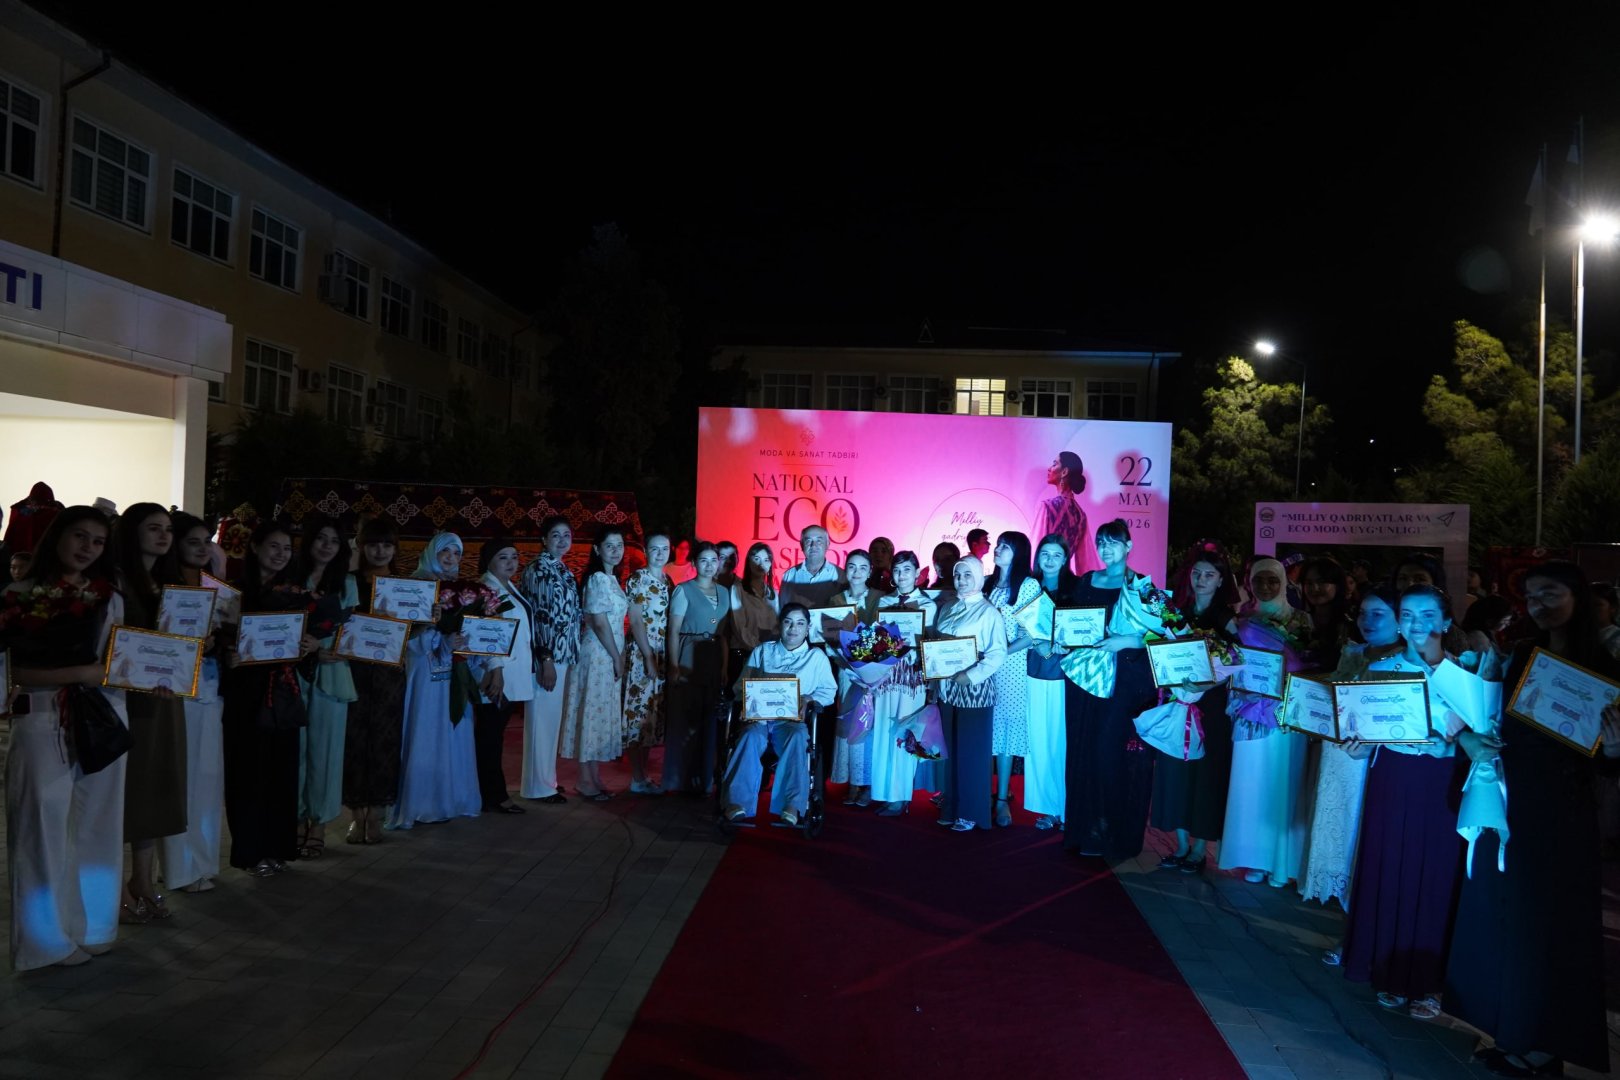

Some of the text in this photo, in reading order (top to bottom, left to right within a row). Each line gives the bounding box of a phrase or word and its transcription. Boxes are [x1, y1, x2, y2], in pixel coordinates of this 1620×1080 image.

[760, 449, 783, 457] MODA
[800, 451, 825, 459] SANAT
[828, 451, 859, 459] TADBIRI
[1120, 456, 1152, 486] 22
[752, 473, 853, 493] NATIONAL
[1119, 492, 1151, 506] MAY
[752, 496, 860, 544] ECO
[1125, 518, 1151, 528] 026
[1330, 514, 1413, 523] QADRIYATLAR
[1417, 514, 1431, 522] VA
[1288, 525, 1310, 533] ECO
[1313, 525, 1347, 533] MODA
